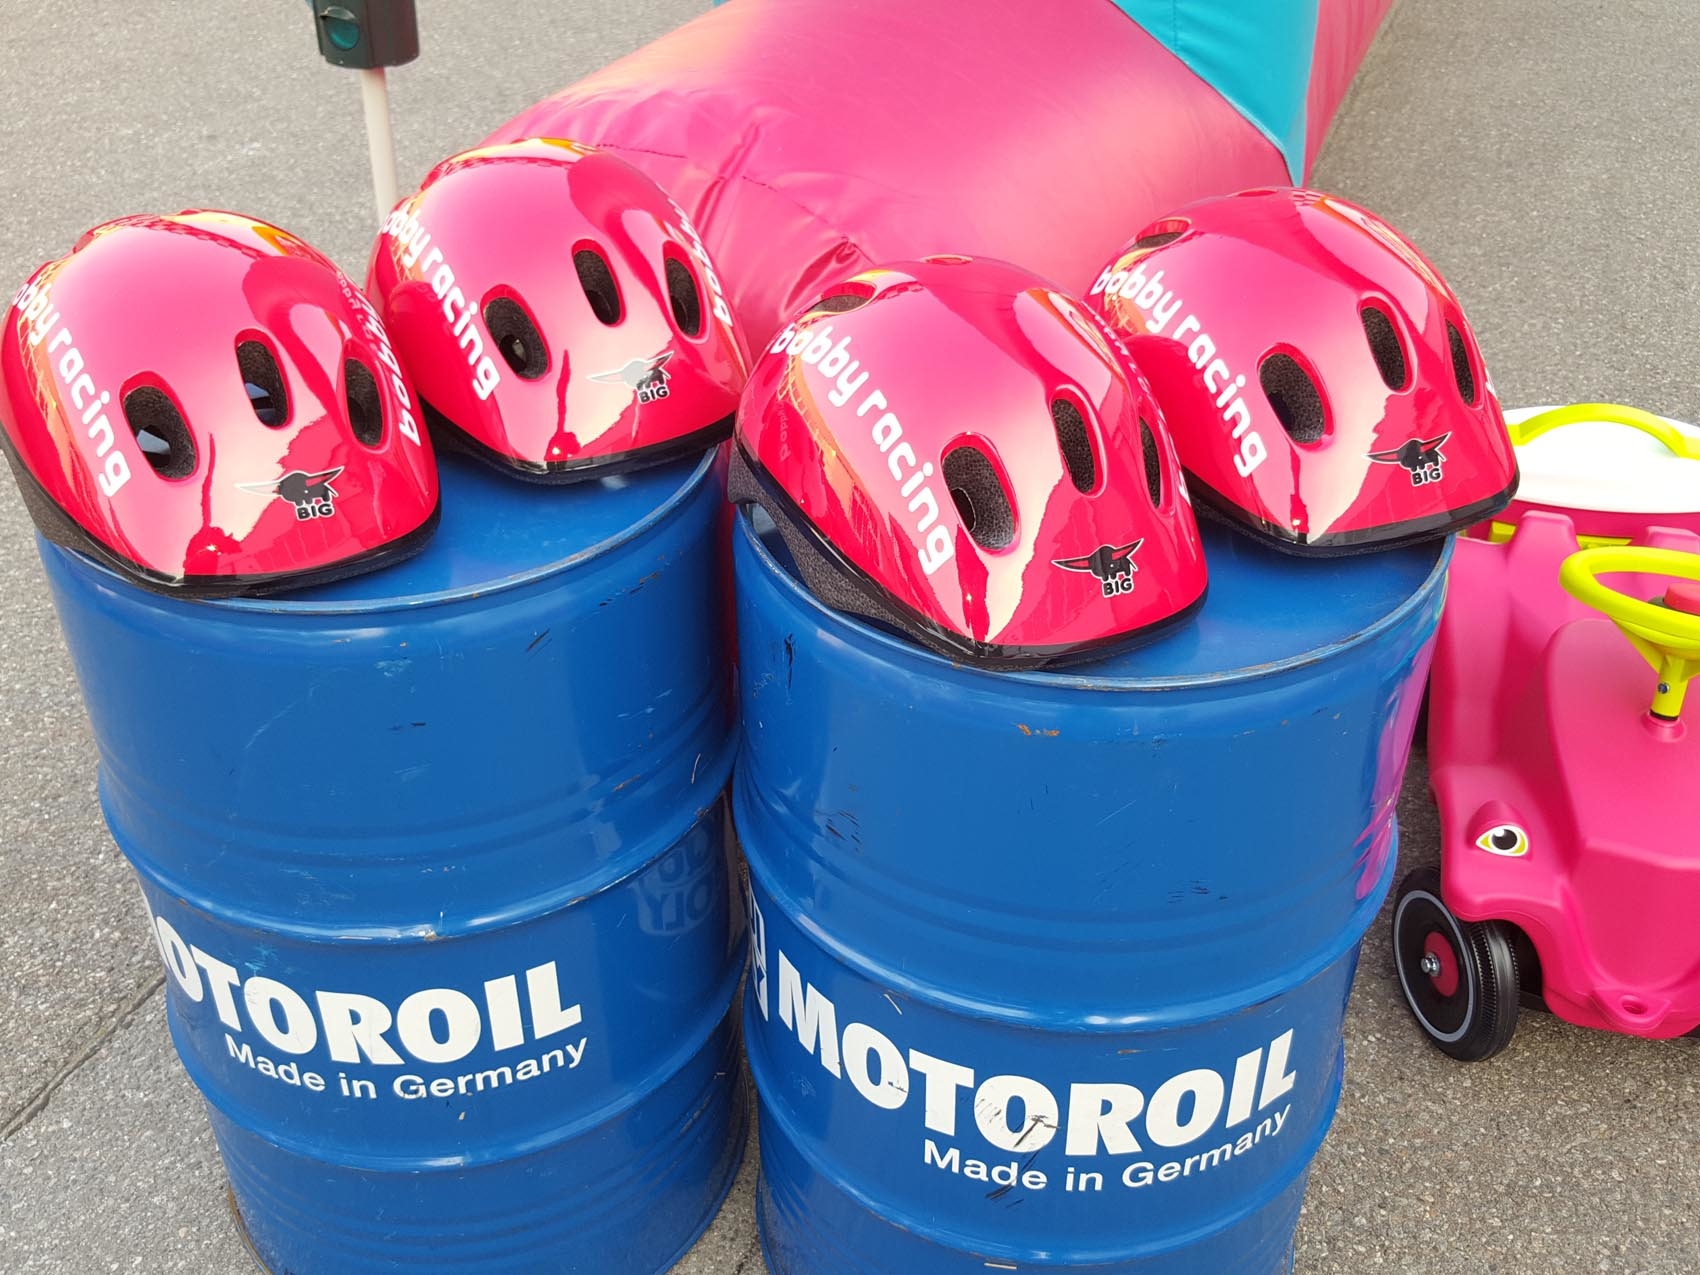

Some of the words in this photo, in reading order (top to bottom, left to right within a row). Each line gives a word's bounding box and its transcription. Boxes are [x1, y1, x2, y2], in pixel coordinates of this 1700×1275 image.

[377, 203, 431, 268] obby
[421, 247, 500, 400] racing
[12, 276, 60, 346] obby
[48, 328, 131, 497] racing
[638, 385, 670, 404] BIG
[1090, 264, 1183, 333] bobby
[1172, 314, 1268, 478] racing
[297, 503, 333, 520] BIG
[770, 323, 869, 407] bobby
[856, 389, 954, 575] racing
[1411, 467, 1442, 486] BIG
[1103, 577, 1133, 596] BIG
[138, 880, 582, 1065] OTOROIL
[226, 1034, 325, 1092] Made
[340, 1072, 377, 1100] in
[393, 1036, 588, 1100] Germany
[778, 949, 1297, 1156] MOTOROIL
[924, 1139, 1048, 1190] Made
[1066, 1167, 1102, 1192] in
[1122, 1103, 1292, 1188] Germany
